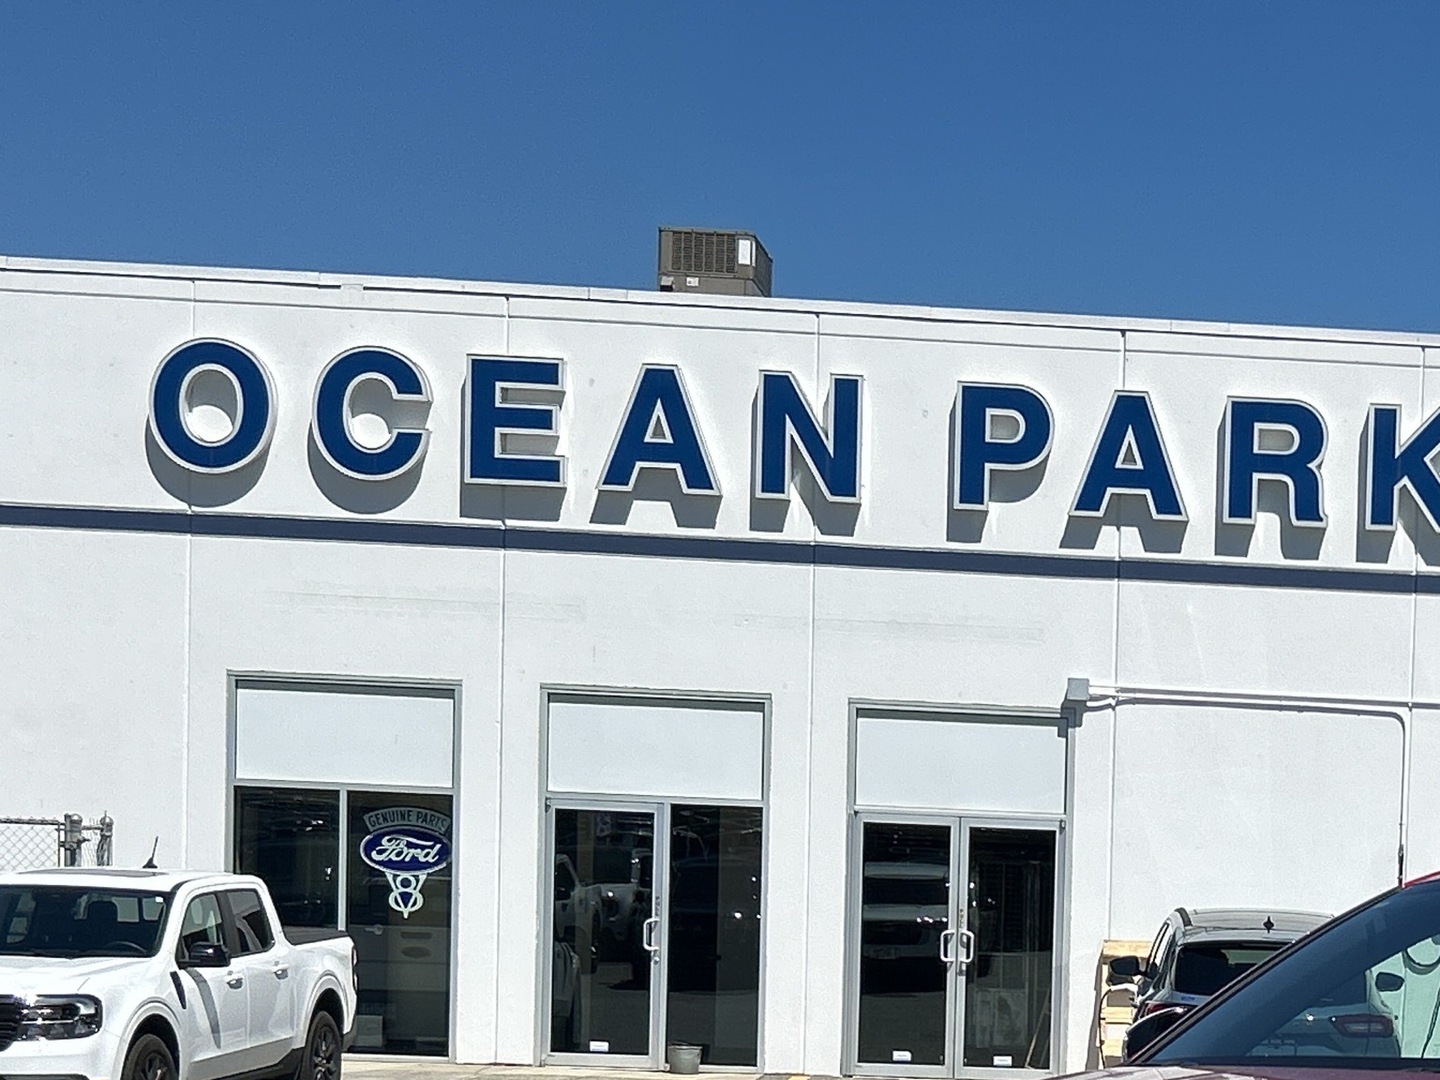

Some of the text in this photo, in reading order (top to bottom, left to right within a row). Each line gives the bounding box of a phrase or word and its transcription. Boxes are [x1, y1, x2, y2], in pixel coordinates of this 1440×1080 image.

[149, 337, 864, 504] OCEAN
[368, 809, 447, 830] GENUINE PARTS
[371, 834, 442, 863] Ford
